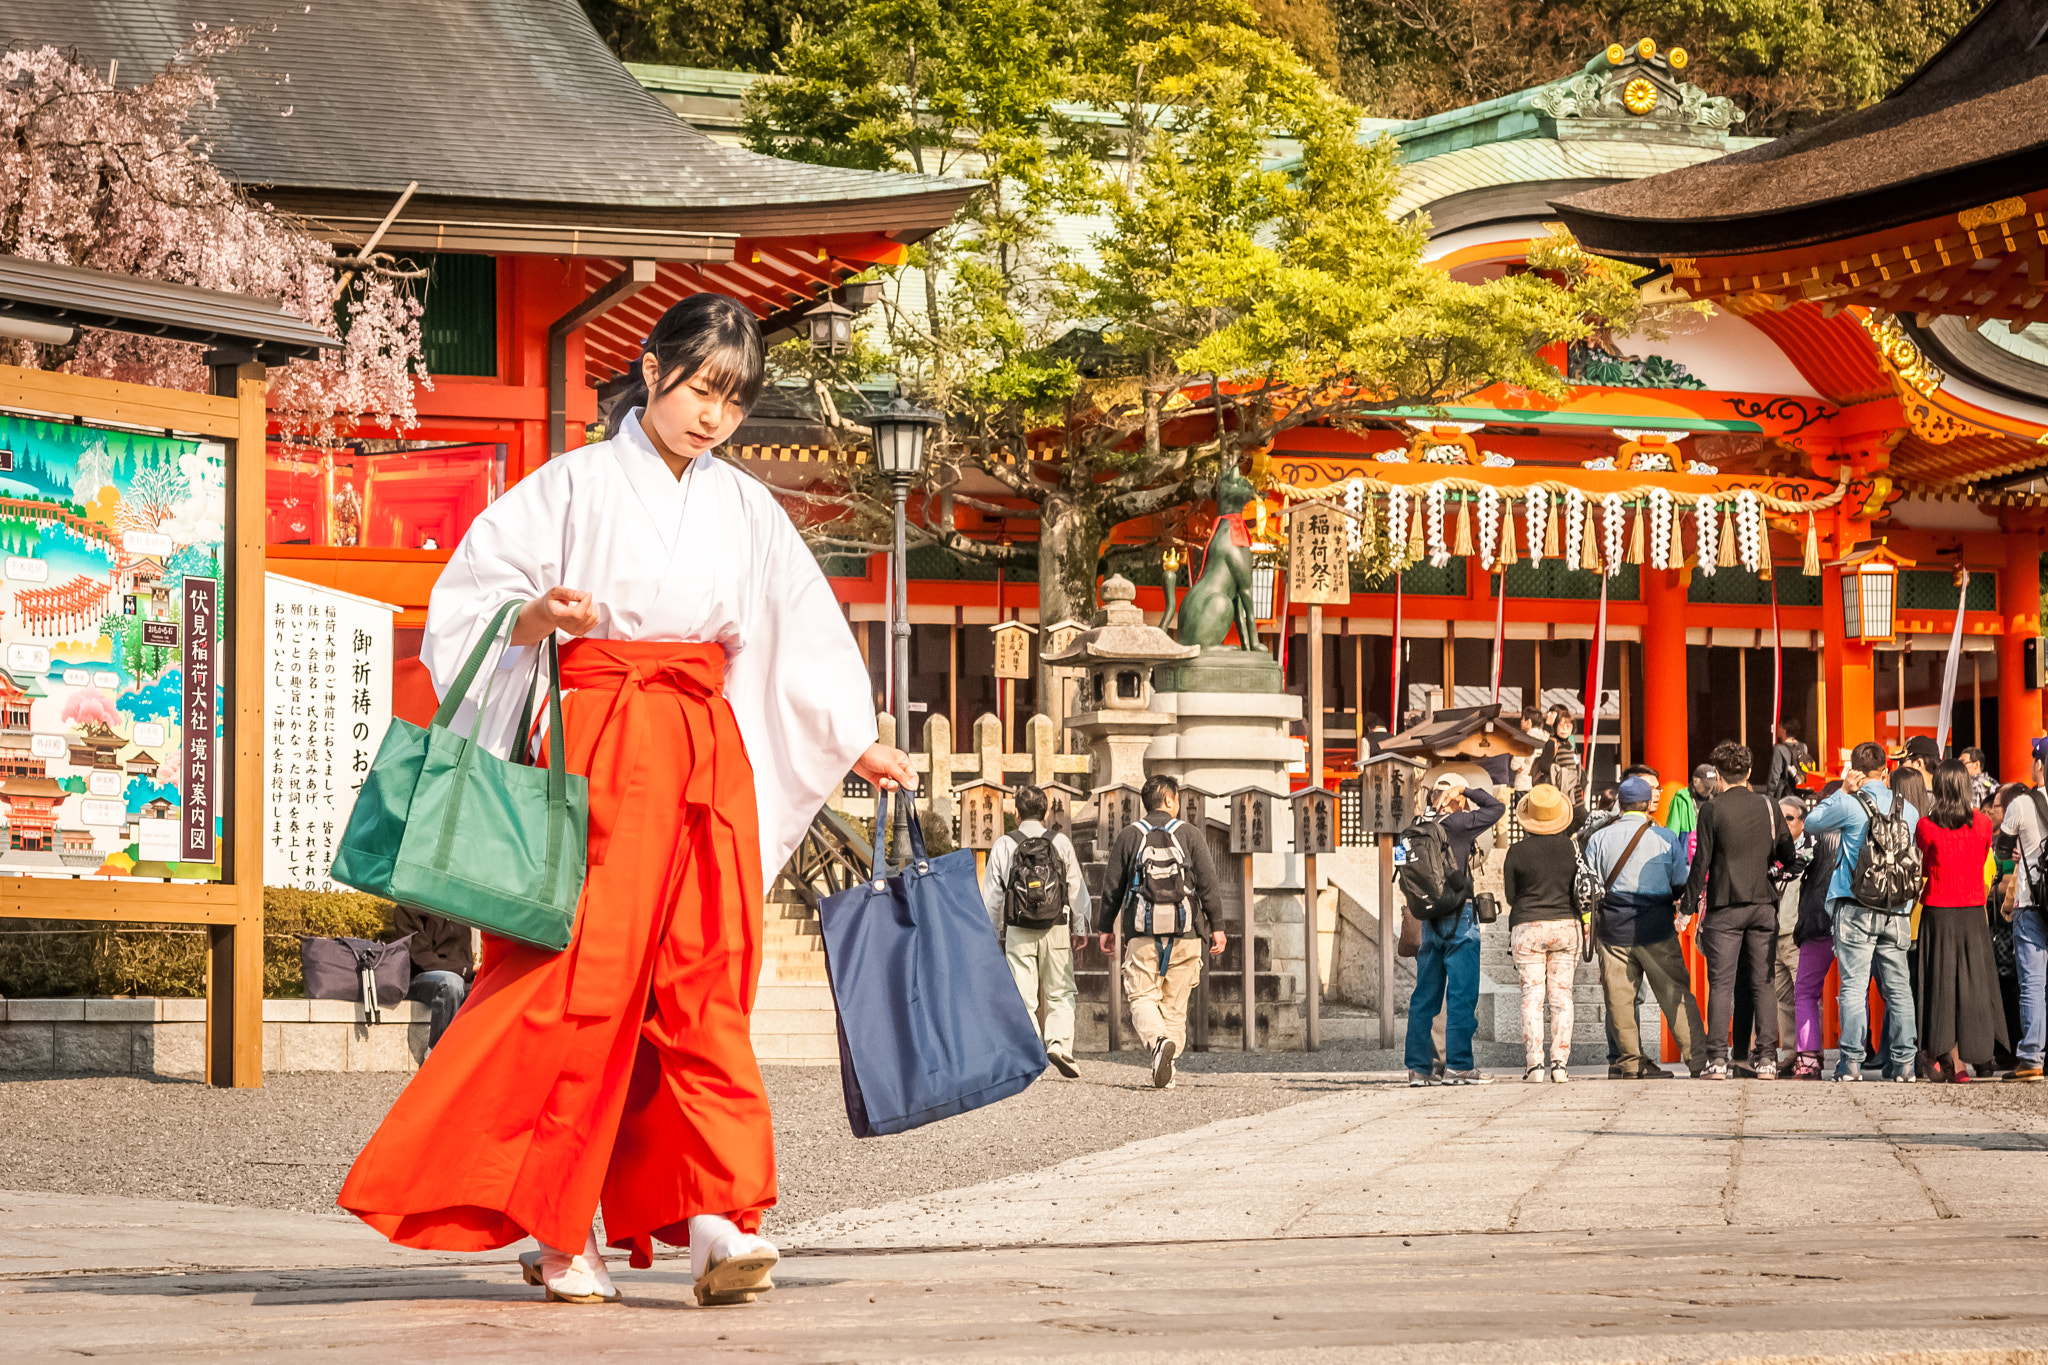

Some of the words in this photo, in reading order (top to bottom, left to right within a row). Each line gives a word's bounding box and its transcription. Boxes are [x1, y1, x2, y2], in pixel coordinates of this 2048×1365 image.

[1308, 513, 1331, 592] 稲荷祭
[189, 589, 209, 731] 伏見稲荷大社
[189, 738, 208, 850] 境内案内図
[1390, 769, 1405, 827] 天皇陛下
